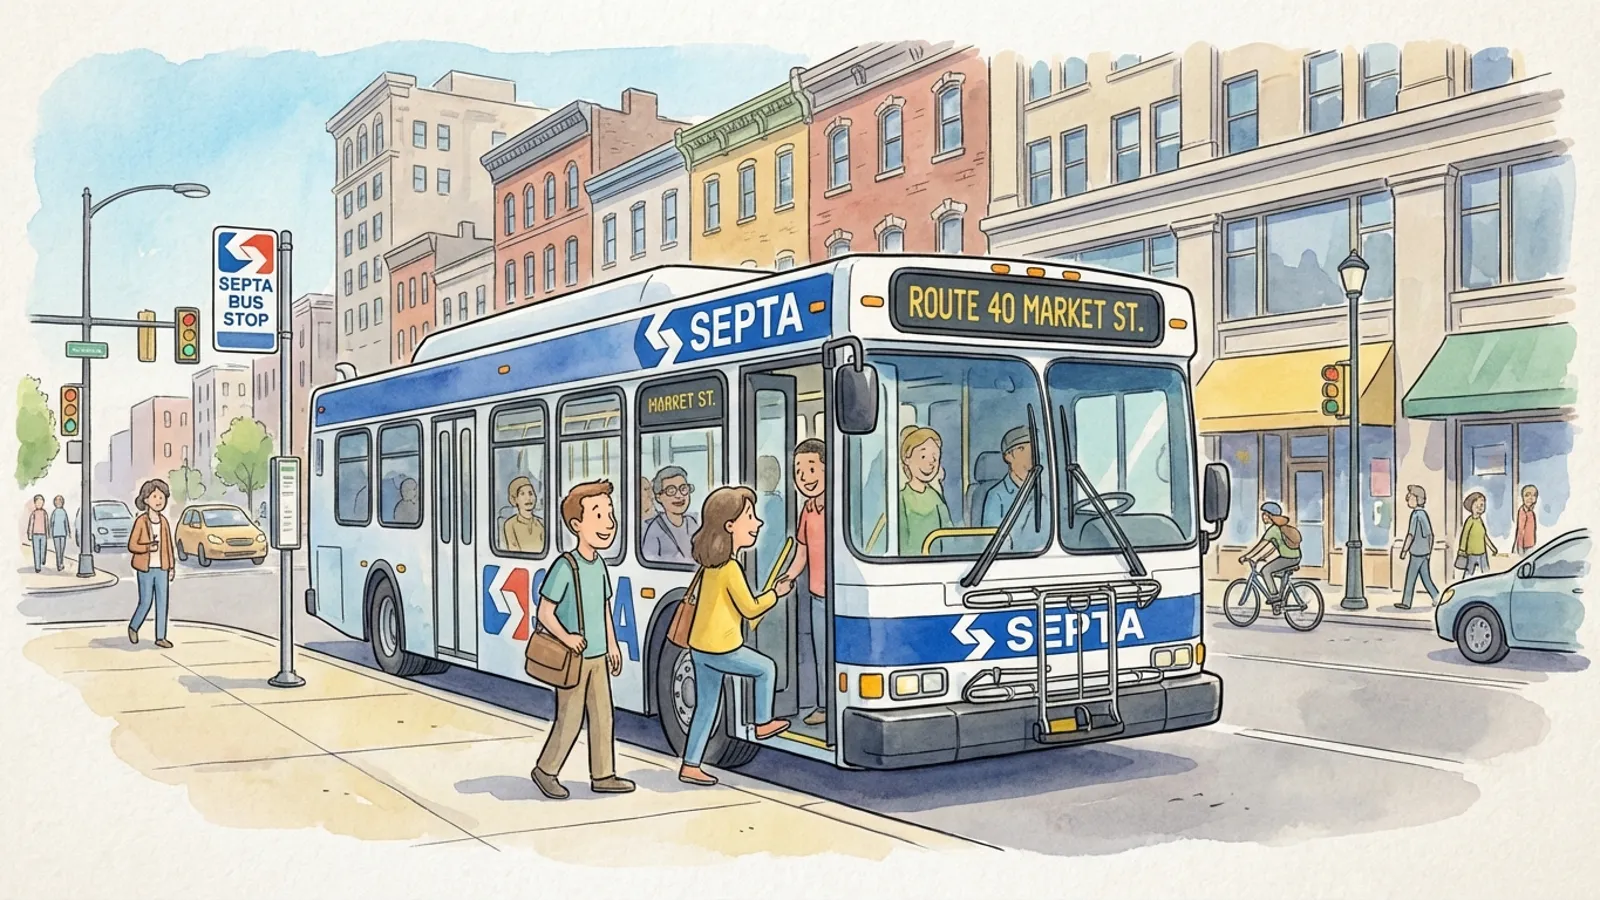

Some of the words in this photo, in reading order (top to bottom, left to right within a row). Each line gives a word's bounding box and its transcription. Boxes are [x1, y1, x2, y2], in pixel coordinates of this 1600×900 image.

[219, 276, 273, 293] SEPTA
[229, 295, 264, 309] BUS
[909, 285, 980, 321] ROUTE
[987, 291, 1015, 324] 40
[1023, 293, 1107, 329] MARKET
[1113, 301, 1144, 333] ST.
[224, 312, 269, 327] STOP
[690, 291, 804, 352] SEPTA
[698, 390, 716, 408] ST.
[1006, 608, 1145, 652] SEPTA
